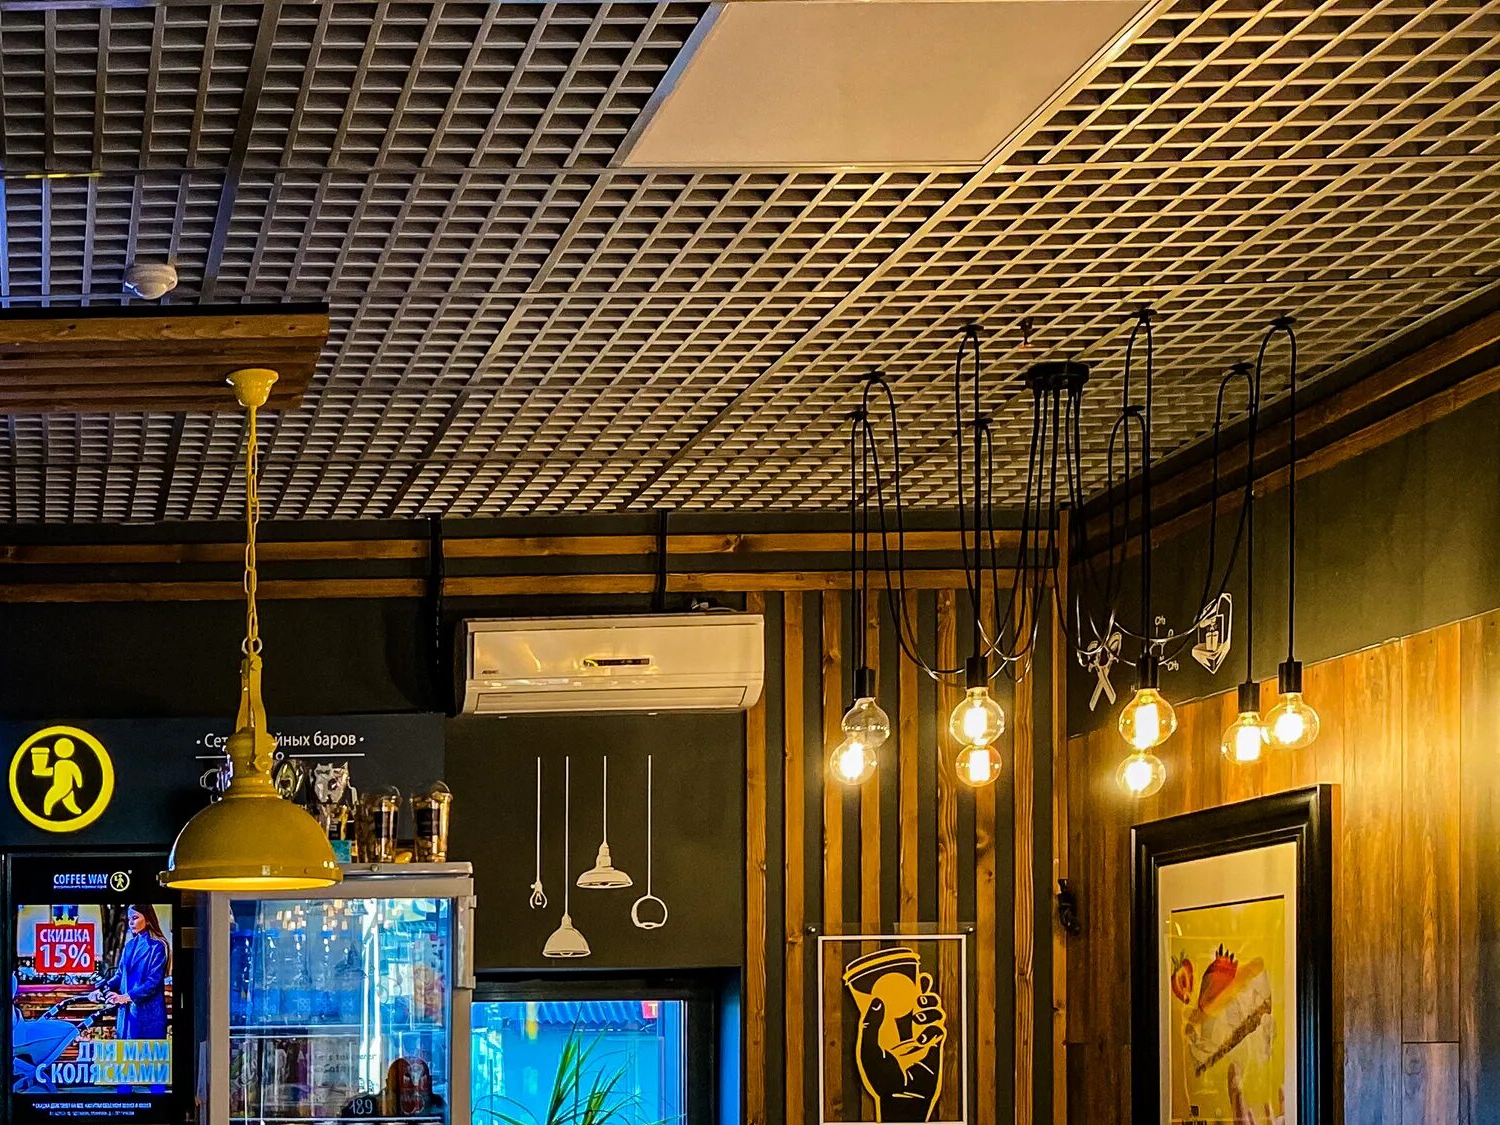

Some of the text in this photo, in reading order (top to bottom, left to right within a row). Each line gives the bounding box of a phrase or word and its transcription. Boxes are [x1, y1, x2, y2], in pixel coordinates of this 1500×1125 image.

[313, 730, 357, 750] баров
[53, 874, 109, 885] COFFEE WAY
[39, 928, 91, 942] СКИДКА
[40, 944, 91, 968] 15%
[76, 1041, 169, 1062] ДЛЯ МАМ
[35, 1063, 170, 1084] С КОЛЯСКАМИ
[350, 1099, 373, 1115] 189
